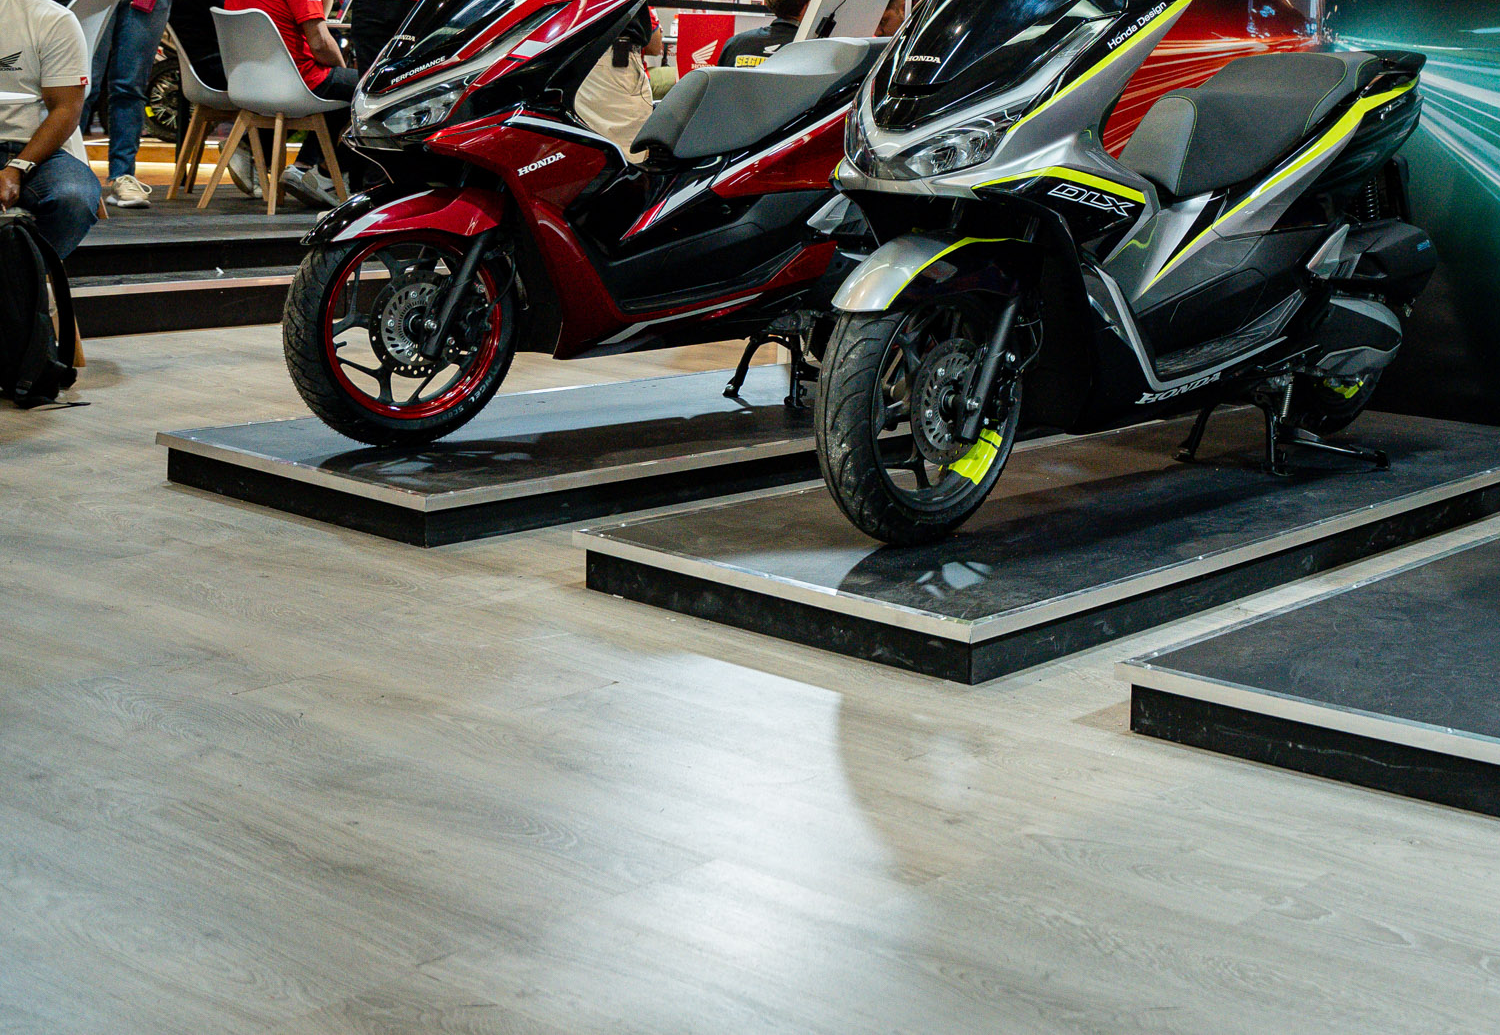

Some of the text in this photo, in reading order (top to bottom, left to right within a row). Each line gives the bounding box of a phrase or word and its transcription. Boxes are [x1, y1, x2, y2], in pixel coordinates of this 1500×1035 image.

[1107, 1, 1167, 50] Honda Design
[390, 55, 446, 85] PERFORMANCE
[905, 55, 941, 64] HONDA
[517, 151, 566, 177] HONDA
[1047, 182, 1136, 217] DLX
[1134, 371, 1222, 405] HONDA
